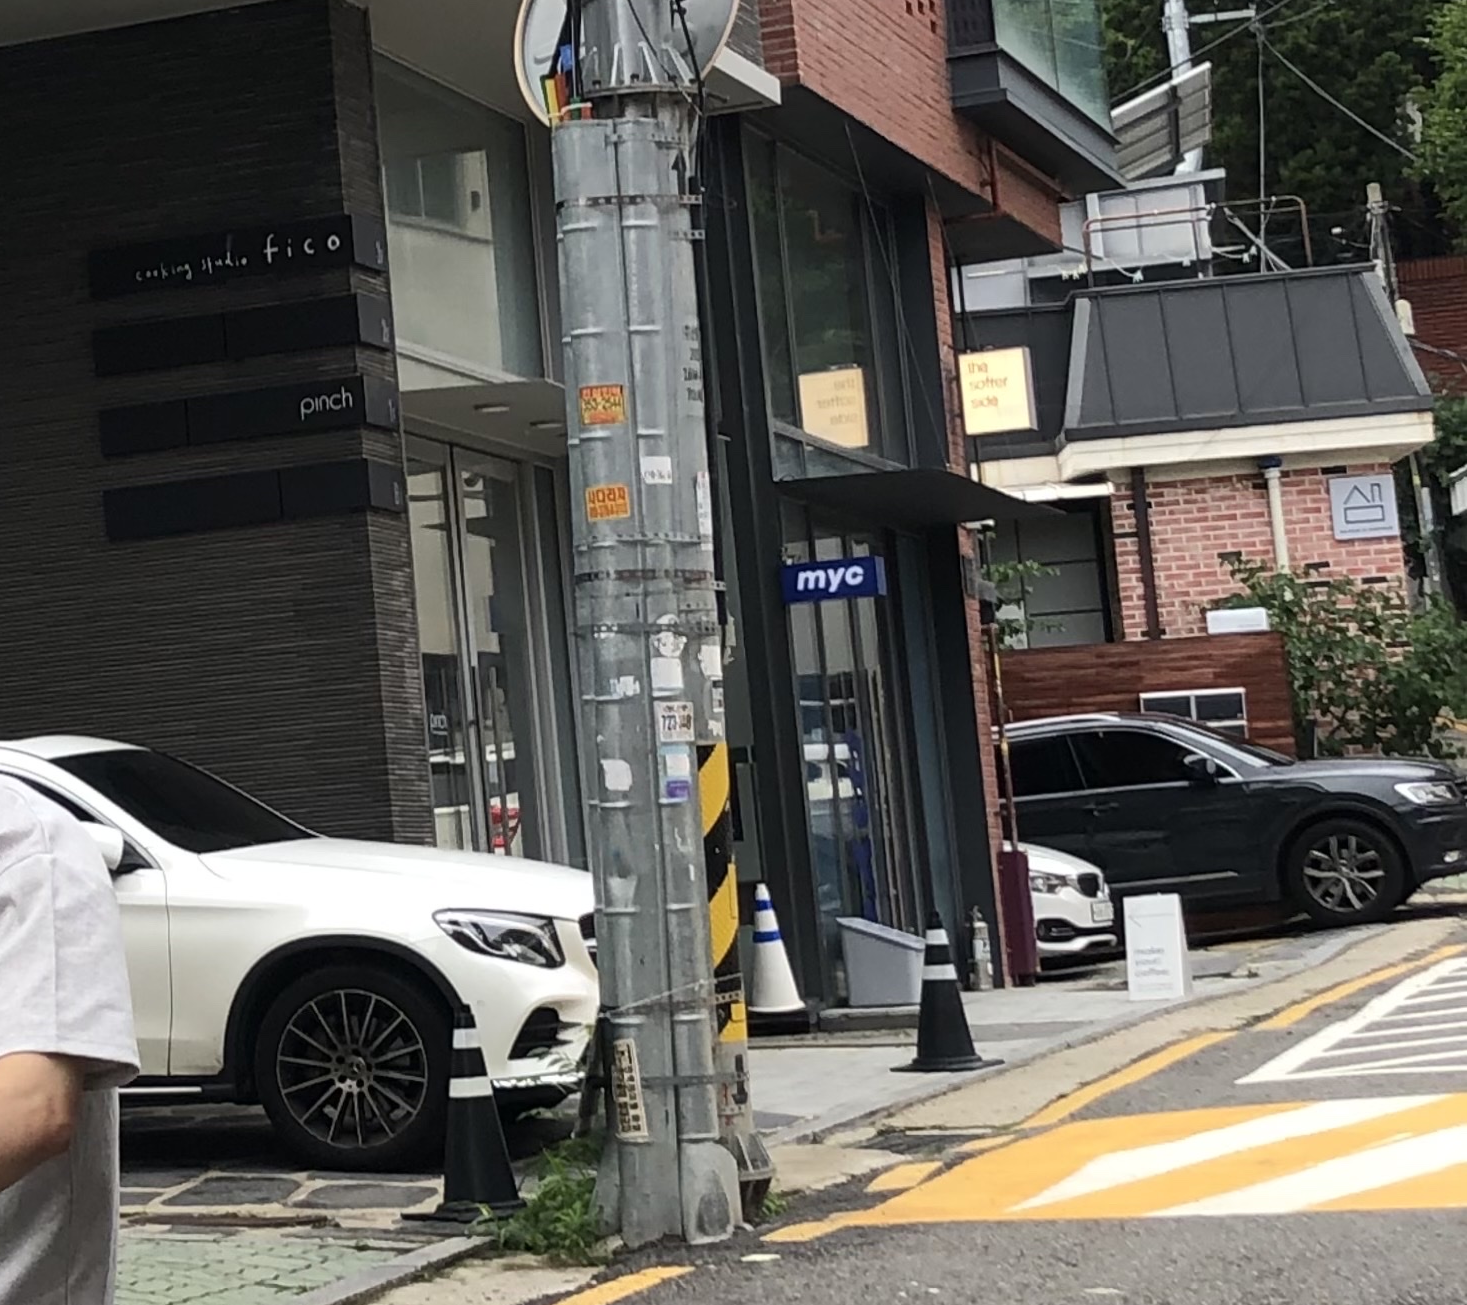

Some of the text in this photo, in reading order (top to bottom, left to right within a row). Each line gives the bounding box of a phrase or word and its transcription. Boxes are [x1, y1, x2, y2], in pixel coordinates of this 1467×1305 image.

[263, 233, 341, 264] fico
[300, 385, 353, 422] pinch
[796, 565, 865, 593] myc
